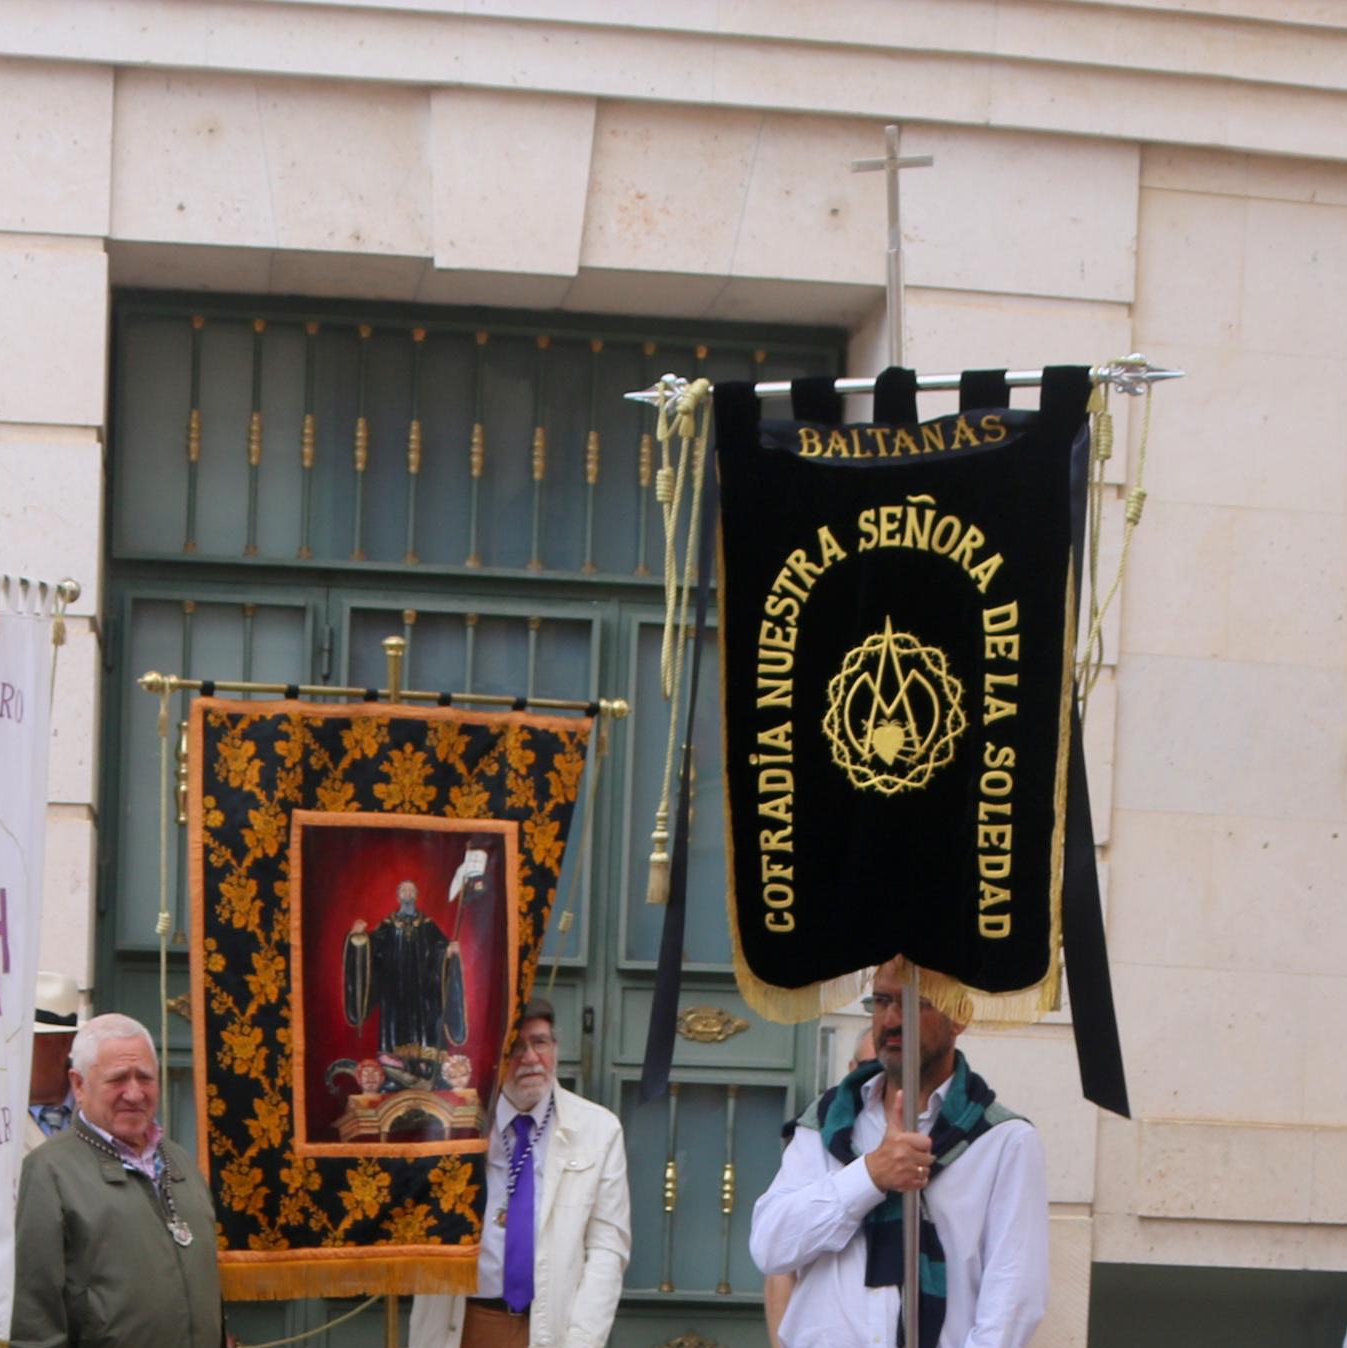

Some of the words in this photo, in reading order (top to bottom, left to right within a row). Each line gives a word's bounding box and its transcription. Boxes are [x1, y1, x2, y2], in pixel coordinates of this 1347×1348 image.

[797, 414, 1007, 458] BALTANAS
[857, 494, 1005, 595] SEÑORA
[756, 525, 848, 710] NUESTRA
[982, 600, 1020, 661] DE
[983, 673, 1019, 726] LA
[977, 741, 1016, 940] SOLEDAD
